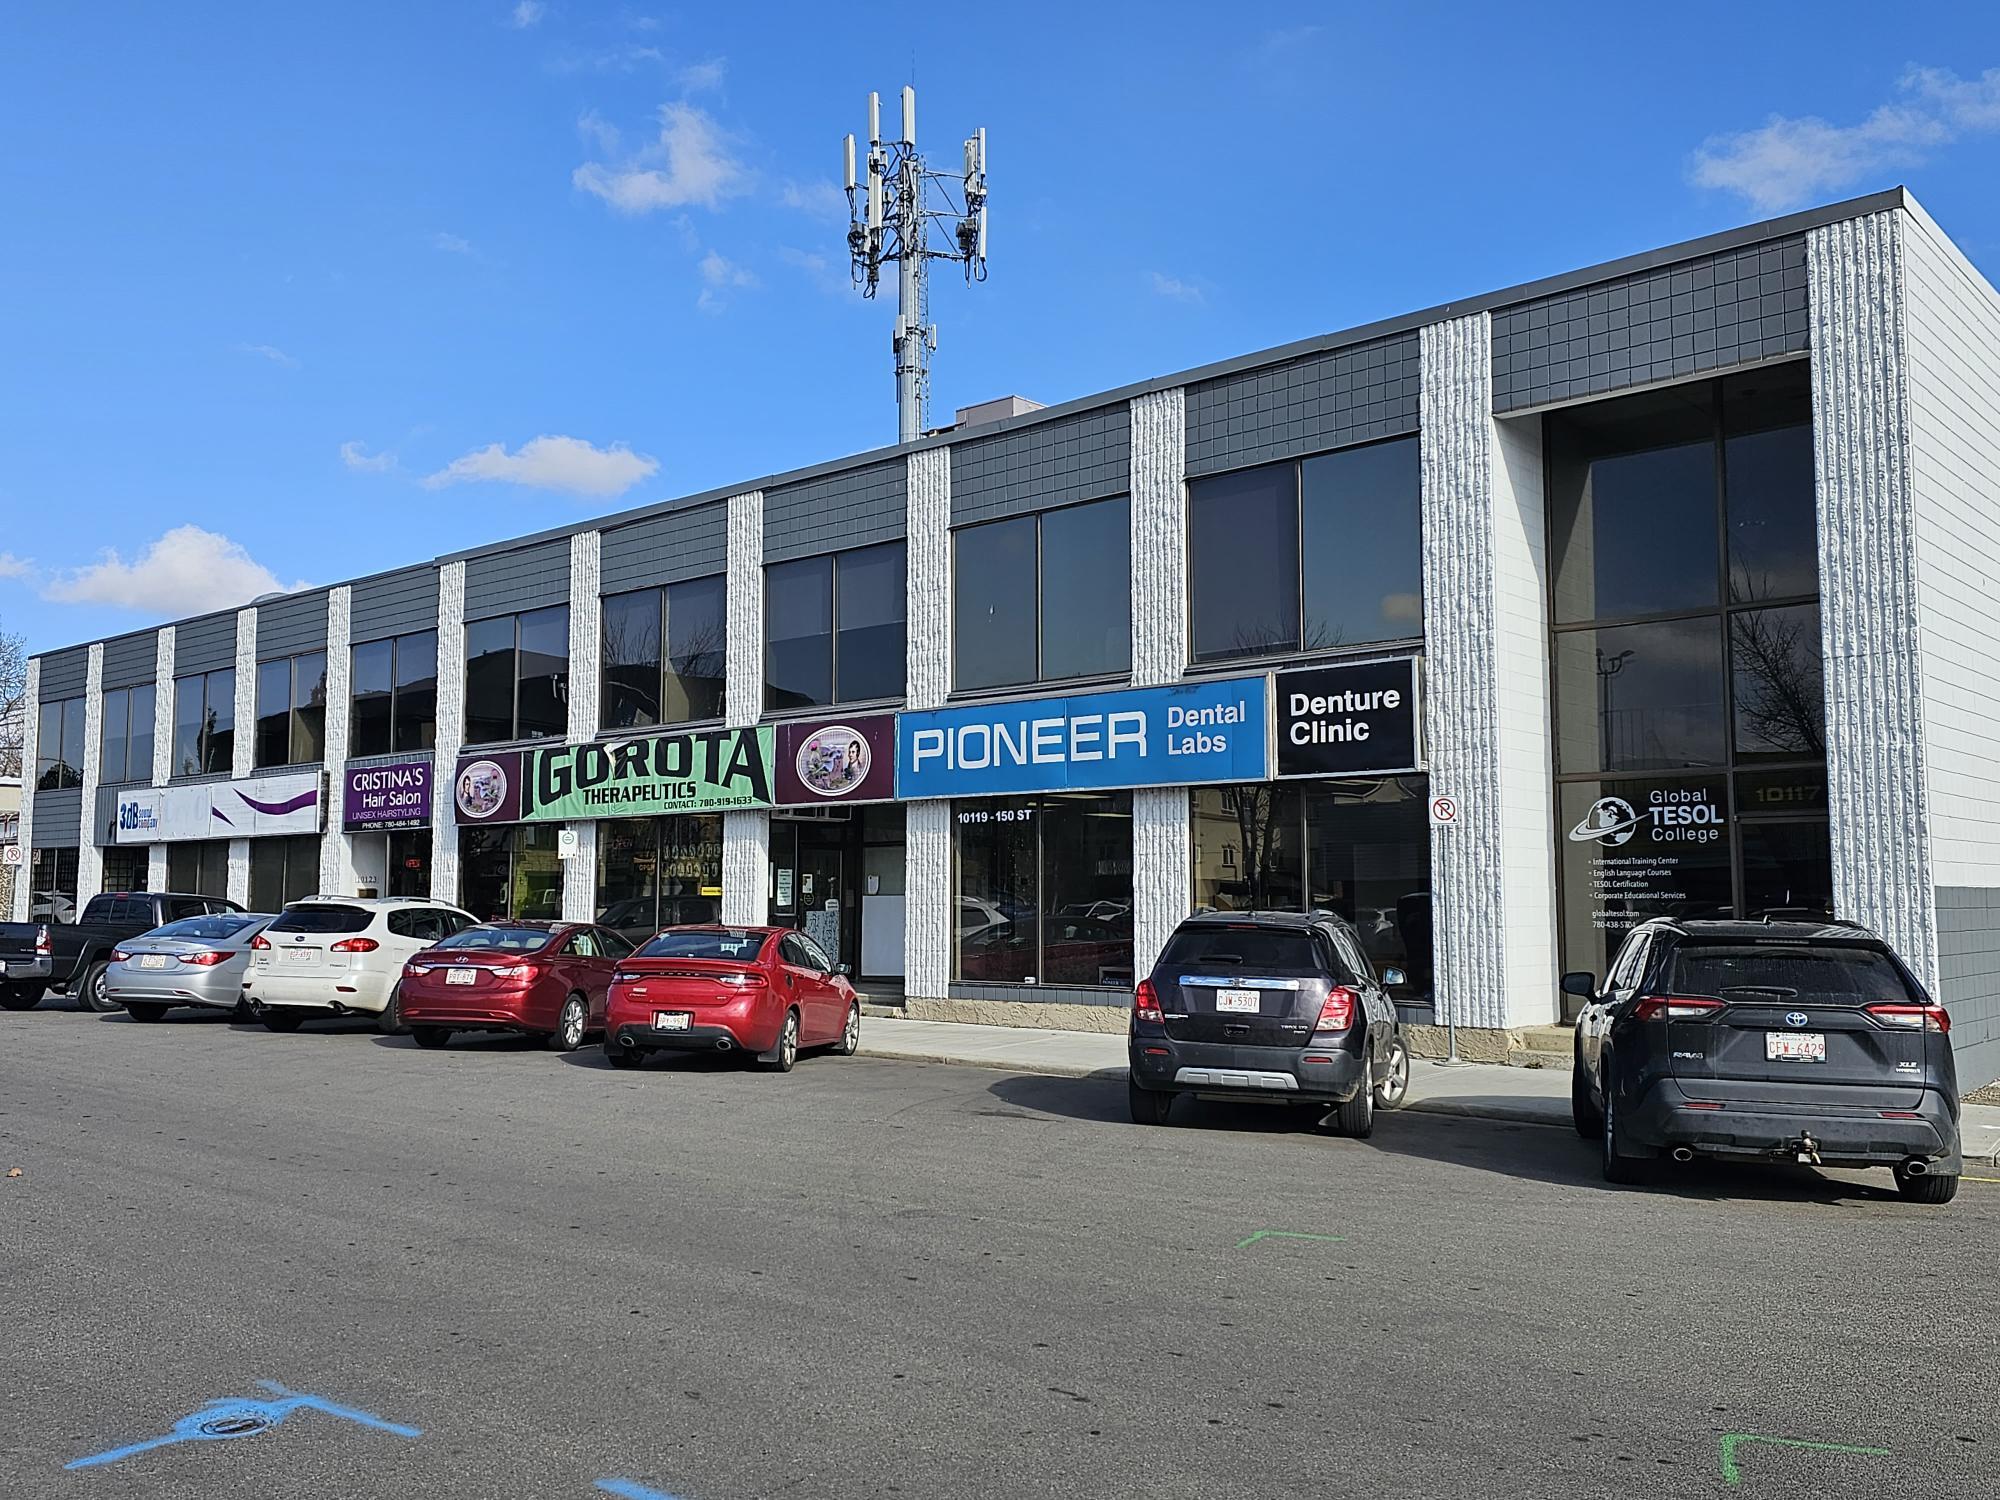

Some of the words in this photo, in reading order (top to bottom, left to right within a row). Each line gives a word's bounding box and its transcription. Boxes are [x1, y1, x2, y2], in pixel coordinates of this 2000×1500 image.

[1291, 687, 1400, 716] Denture
[1167, 700, 1246, 729] Dental
[1289, 718, 1371, 746] Clinic
[912, 710, 1147, 773] PIONEER
[1167, 732, 1227, 756] Labs
[353, 768, 424, 792] CRISTINA'S
[363, 792, 387, 808] Hair
[389, 789, 421, 806] Salon
[583, 781, 697, 805] THERAPEUTICS
[1650, 788, 1707, 803] Global
[664, 800, 697, 810] CONTACT:
[120, 801, 139, 830] 3dB
[352, 810, 377, 820] UNISEX
[377, 807, 421, 818] HAIRSTYLING
[957, 811, 988, 823] 10119
[995, 810, 1014, 821] 150
[1017, 809, 1032, 820] ST
[1648, 804, 1725, 825] TESOL
[362, 821, 384, 829] PHONE:
[1652, 827, 1719, 843] College
[1592, 857, 1632, 866] International
[1632, 857, 1656, 866] Training
[1657, 856, 1679, 865] Center
[1593, 869, 1616, 878] English
[1616, 869, 1646, 878] Language
[1647, 868, 1672, 876] Courses
[1593, 880, 1611, 888] TESOL
[1612, 880, 1649, 888] Certification
[1594, 892, 1624, 900] Corporate
[1624, 891, 1660, 899] Educational
[1660, 891, 1687, 899] Services
[1592, 909, 1640, 918] globaltesol.com
[1218, 995, 1258, 1007] CJW-5307
[1769, 1041, 1825, 1056] CFW-6429
